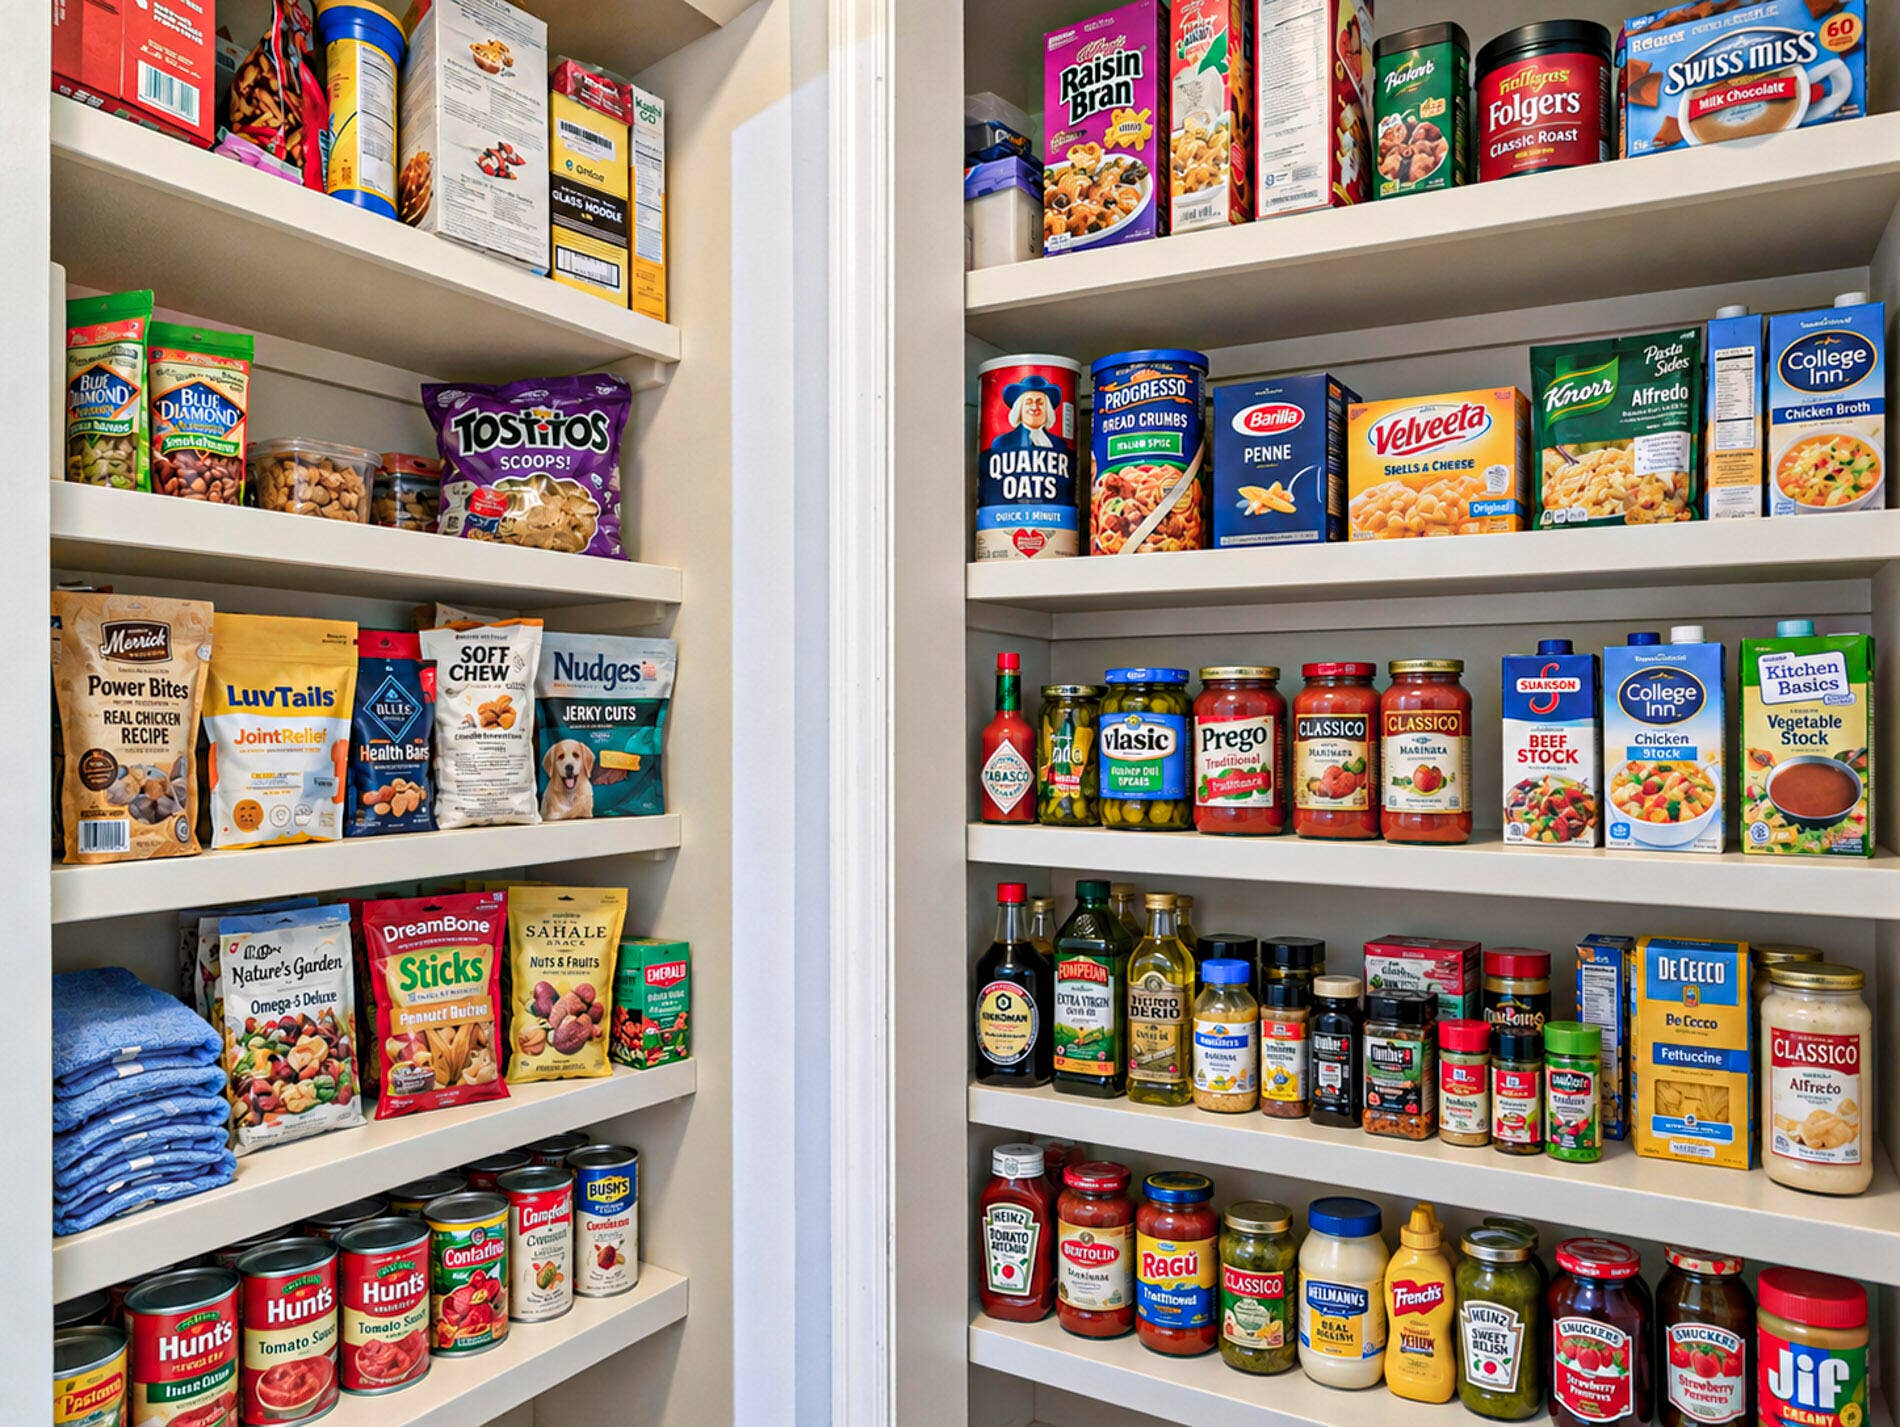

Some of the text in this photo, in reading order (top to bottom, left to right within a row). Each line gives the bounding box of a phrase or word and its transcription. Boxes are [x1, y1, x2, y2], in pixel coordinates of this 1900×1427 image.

[1827, 18, 1855, 38] 60
[1060, 49, 1143, 105] Raisin
[1067, 78, 1134, 126] Bran
[1726, 80, 1786, 104] Chocolate
[1488, 90, 1582, 133] Folgers
[1643, 342, 1684, 366] Pasta
[1788, 346, 1867, 372] College
[1654, 355, 1690, 378] Sides
[1809, 366, 1844, 386] Inn
[181, 388, 220, 408] BLUE
[1105, 378, 1187, 410] PROGRESSO
[1543, 375, 1615, 412] Knorr
[1631, 382, 1689, 407] Alfredo
[160, 399, 240, 428] DIAMOND
[1138, 412, 1188, 429] CRUMBS
[1249, 408, 1298, 428] Barilla
[1785, 401, 1871, 421] Chicken Broth
[452, 407, 610, 456] TOSTITOS
[1374, 402, 1486, 455] Velveeta
[500, 455, 571, 470] SCOOPS!
[1243, 444, 1292, 464] PENNE
[989, 450, 1070, 480] QUAKER
[1432, 458, 1475, 472] CHEESE
[1002, 476, 1057, 500] OATS
[1473, 502, 1510, 515] Original
[101, 630, 166, 654] Merrick
[460, 646, 511, 664] SOFT
[449, 665, 510, 682] CHEW
[553, 651, 641, 692] Nudges
[1765, 660, 1840, 680] Kitchen
[88, 675, 188, 699] Power Bites
[227, 685, 335, 707] LuvTails
[1626, 683, 1698, 705] College
[1778, 677, 1840, 697] Basics
[103, 710, 181, 726] REAL CHICKEN
[562, 705, 637, 722] JERKY CUTS
[1645, 702, 1676, 717] Inn
[1298, 719, 1366, 738] CLASSICO
[1388, 713, 1459, 732] CLASSICO
[1767, 714, 1842, 732] Vegetable
[121, 728, 170, 745] RECIPE
[234, 727, 328, 746] JointRelief
[1200, 725, 1267, 752] Prego
[1529, 734, 1567, 748] BEEF
[1634, 733, 1689, 745] Chicken
[1781, 730, 1829, 746] Stock
[1517, 749, 1580, 765] STOCK
[1643, 746, 1681, 759] Stock
[984, 769, 1030, 783] TABASCO
[383, 915, 491, 943] DreamBone
[525, 925, 608, 939] SAHALE
[231, 953, 343, 988] Nature's Garden
[399, 951, 484, 992] Sticks
[303, 990, 337, 1007] Deluxe
[1661, 1047, 1723, 1065] Fettuccine
[1773, 1038, 1858, 1065] CLASSICO
[993, 1210, 1025, 1226] HEINZ
[362, 1271, 425, 1305] Hunt's
[1225, 1271, 1282, 1295] CLASSICO
[267, 1286, 333, 1324] Hunt's
[1393, 1285, 1443, 1307] French's
[1471, 1309, 1508, 1327] HEINZ
[158, 1320, 233, 1362] Hunt's
[258, 1336, 310, 1355] Tomato
[1471, 1328, 1508, 1345] SWEET
[1767, 1347, 1850, 1409] Jif
